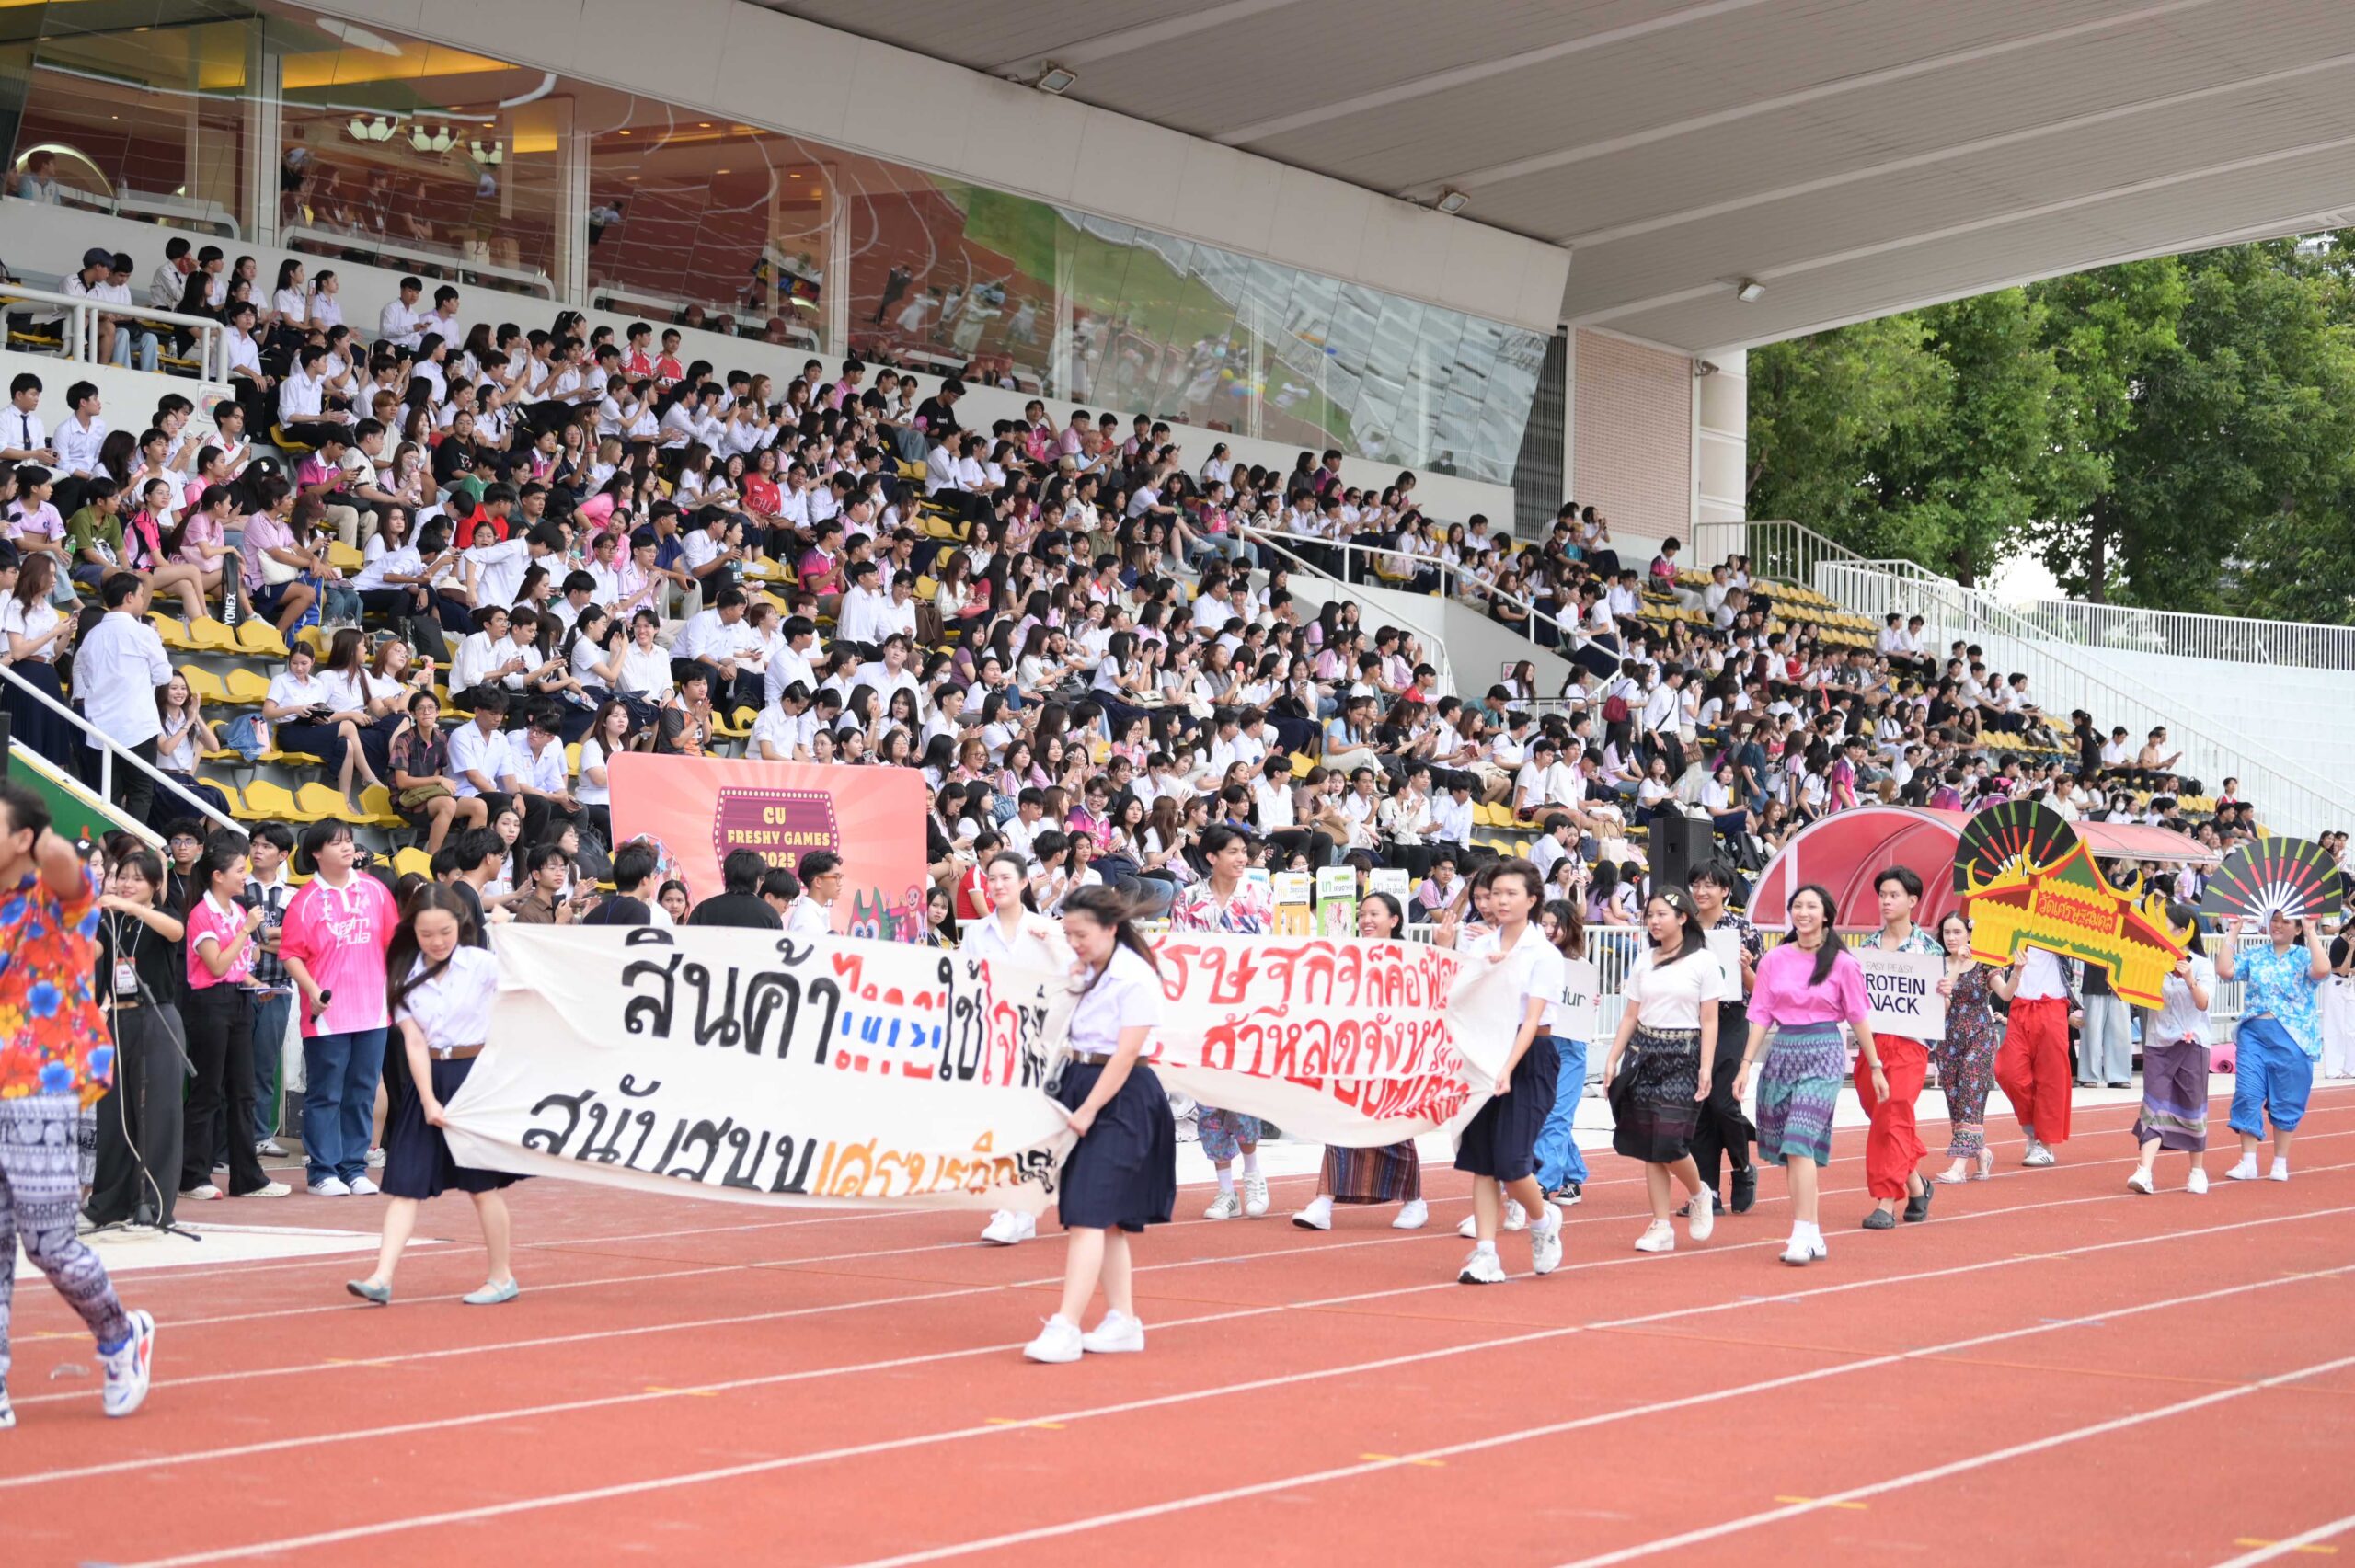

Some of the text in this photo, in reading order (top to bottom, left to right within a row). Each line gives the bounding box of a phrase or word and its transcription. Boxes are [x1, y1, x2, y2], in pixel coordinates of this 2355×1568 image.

[224, 591, 236, 625] YONEX
[763, 807, 787, 825] CU
[728, 830, 831, 847] FRESHY GAMES
[1866, 961, 1913, 974] EASY PEASY
[1862, 973, 1926, 996] ROTEIN
